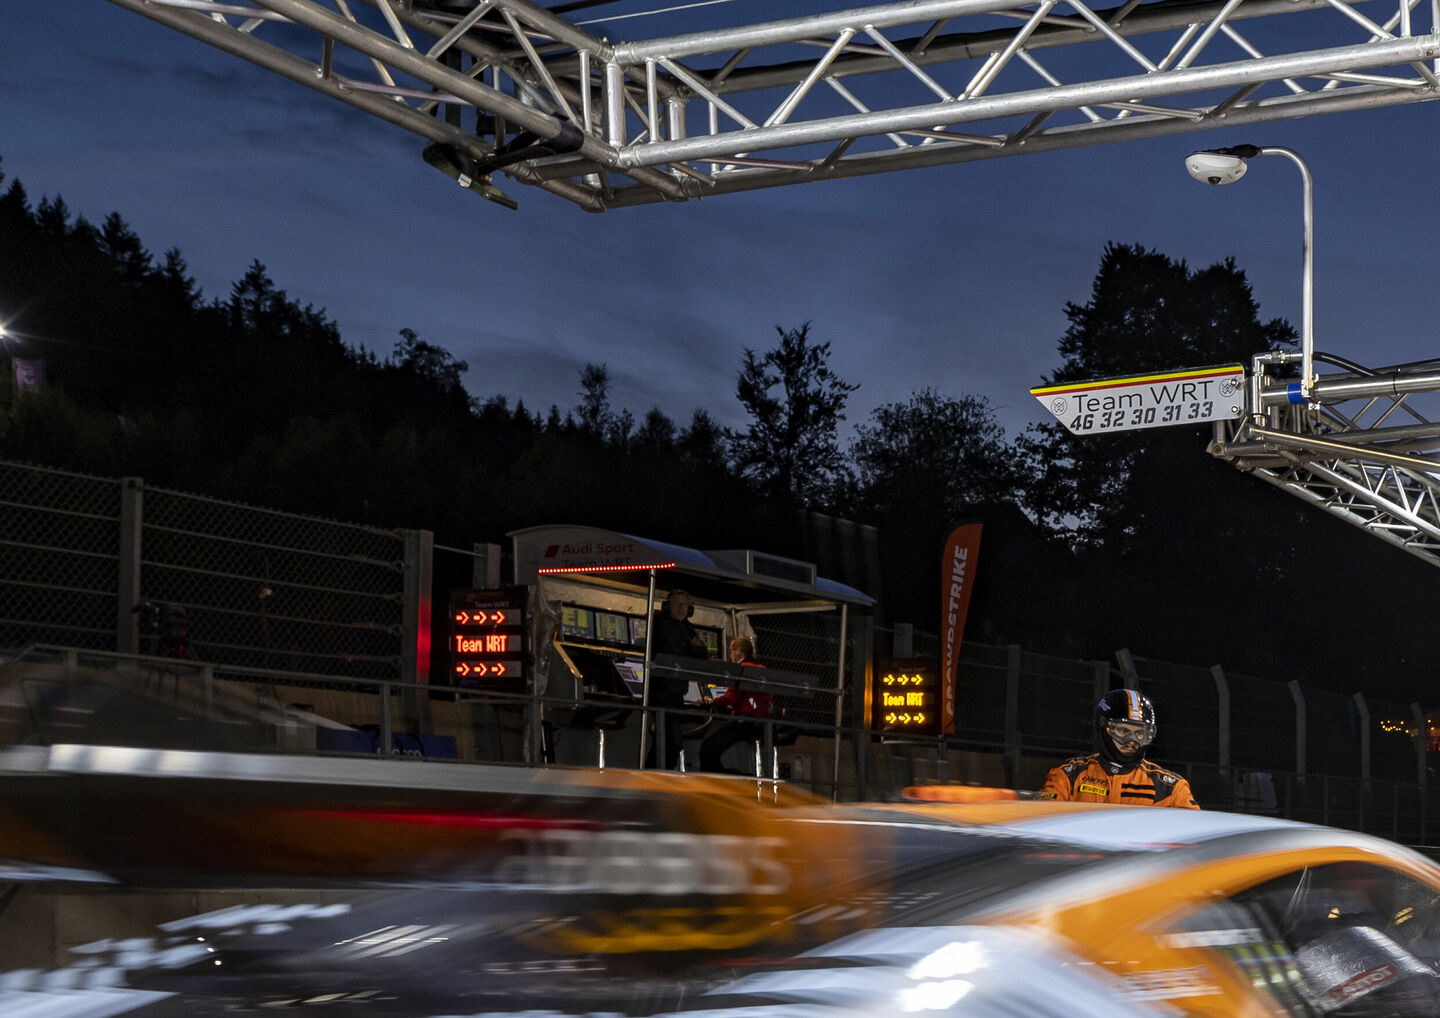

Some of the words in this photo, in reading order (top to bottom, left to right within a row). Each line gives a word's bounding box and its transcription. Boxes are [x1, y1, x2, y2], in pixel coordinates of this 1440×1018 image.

[1072, 393, 1143, 413] Team
[1150, 380, 1214, 405] WRT
[1070, 413, 1094, 431] 46
[1100, 411, 1125, 428] 32
[1131, 408, 1156, 426] 30
[1162, 405, 1182, 422] 31
[1188, 401, 1214, 420] 33
[563, 543, 592, 555] Audi
[596, 542, 634, 556] Sport
[456, 635, 482, 652] Team
[486, 635, 507, 652] WRT
[883, 692, 904, 707] Team
